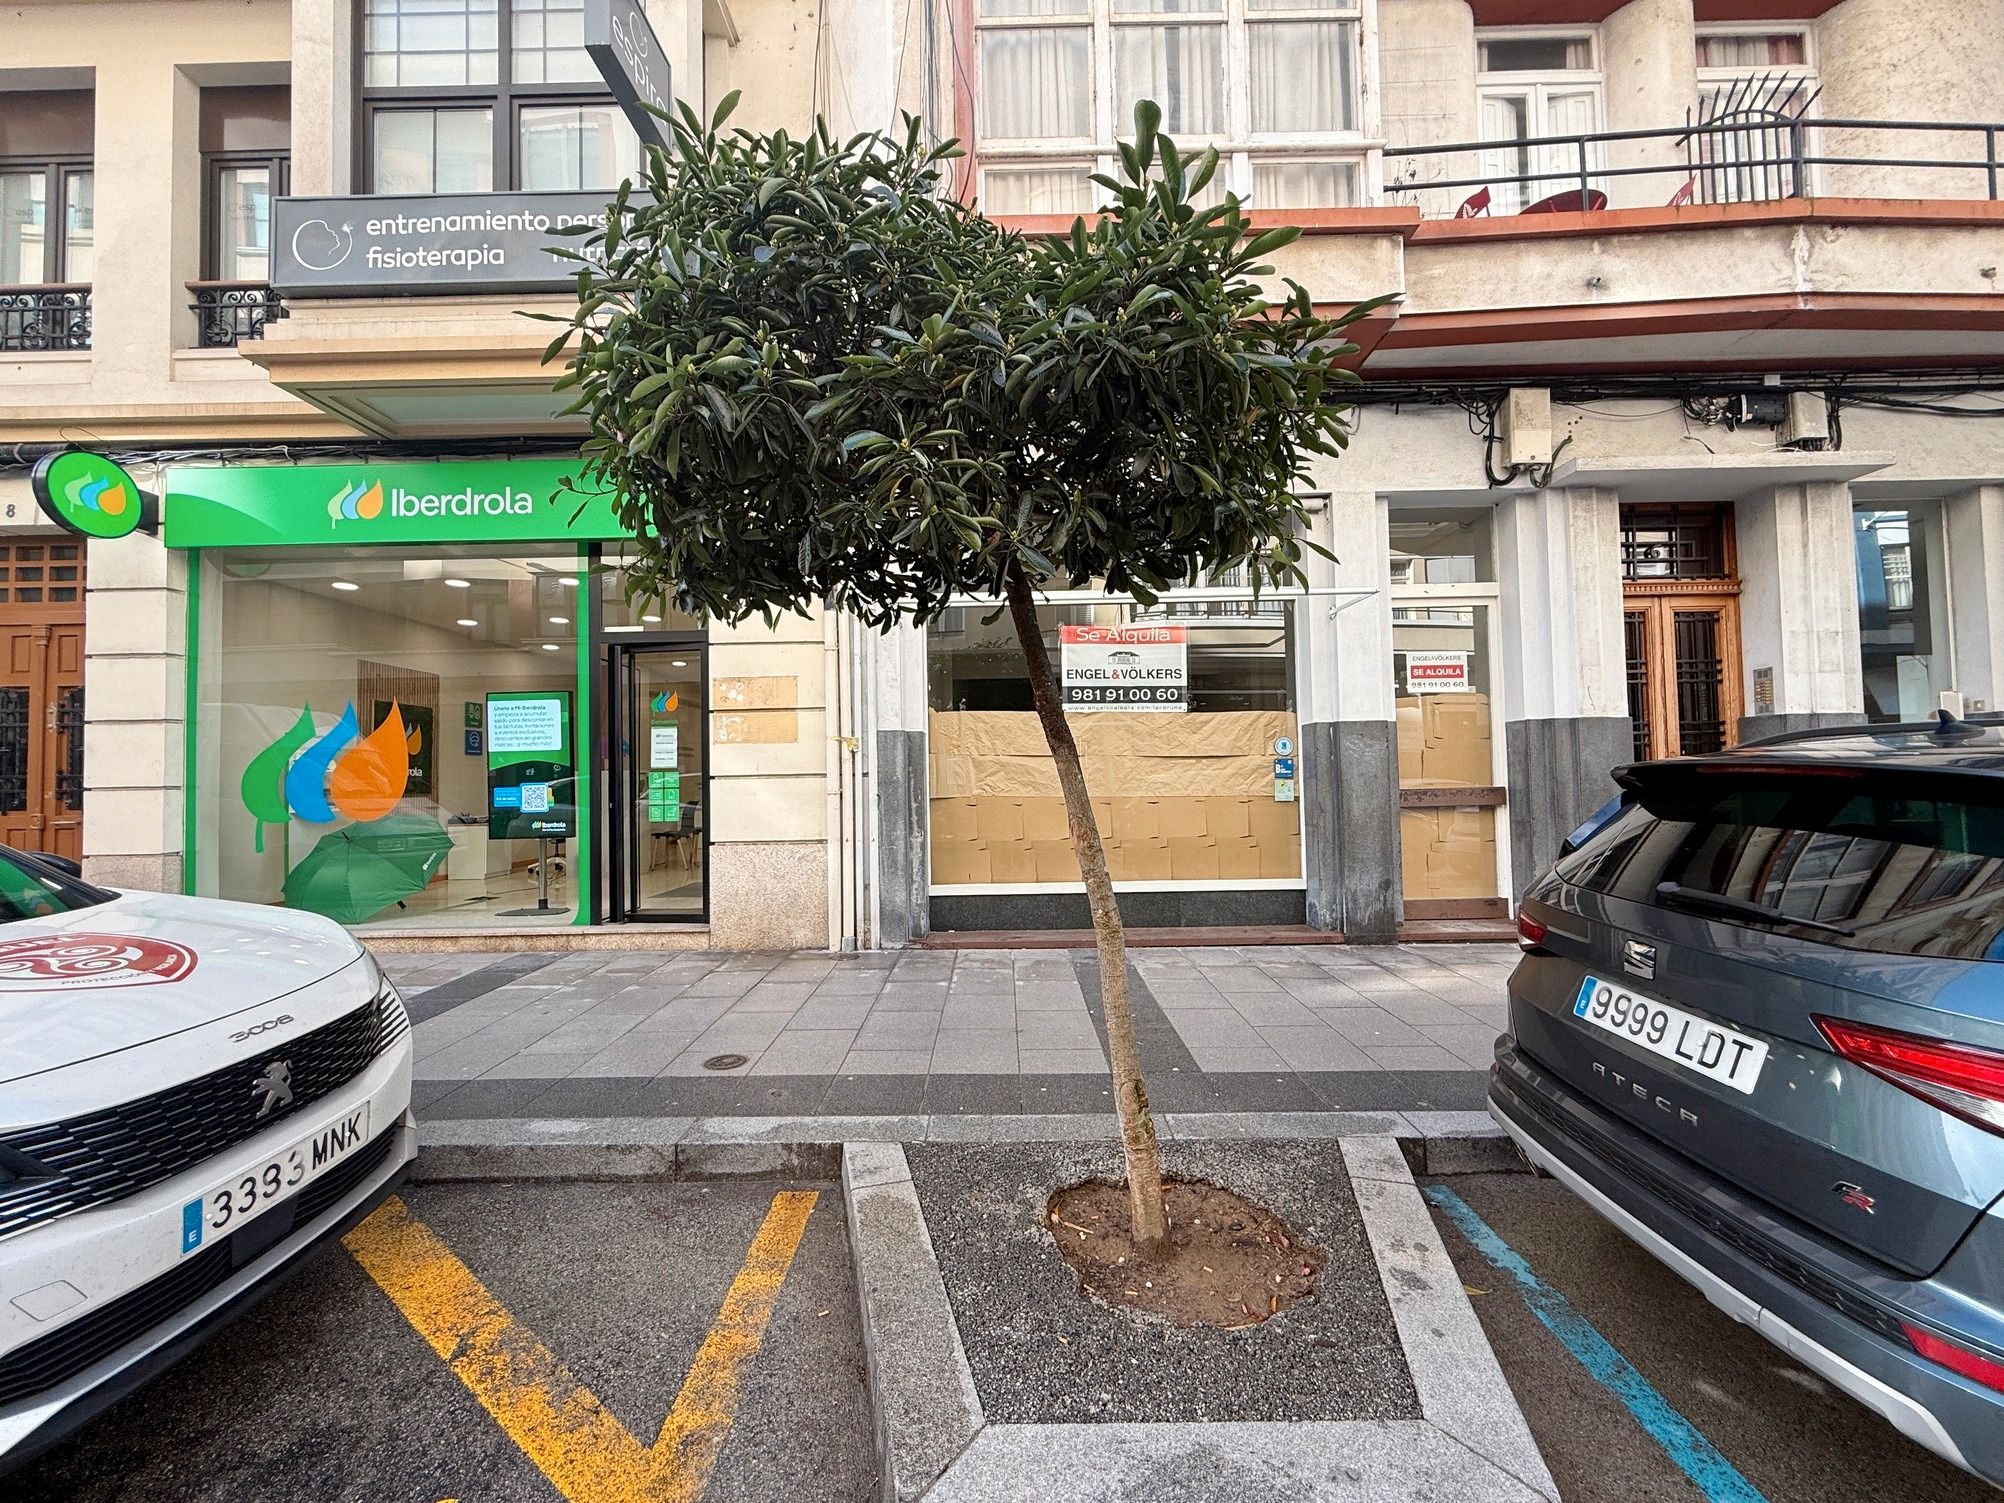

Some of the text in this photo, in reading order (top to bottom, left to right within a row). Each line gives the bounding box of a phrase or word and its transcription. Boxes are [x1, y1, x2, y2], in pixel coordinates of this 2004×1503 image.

[366, 209, 550, 236] entrenamiento
[366, 243, 505, 271] fisioterapia
[6, 504, 16, 518] 8
[391, 486, 533, 517] Iberdrola
[1076, 627, 1171, 644] Se Alquila
[1412, 667, 1462, 676] SE ALQUILA
[1071, 688, 1178, 701] 981 91 00 60
[228, 1014, 294, 1043] 3008
[1592, 985, 1754, 1080] 9999 LDT
[1592, 1061, 1698, 1128] ATECA
[312, 1111, 362, 1171] MNK
